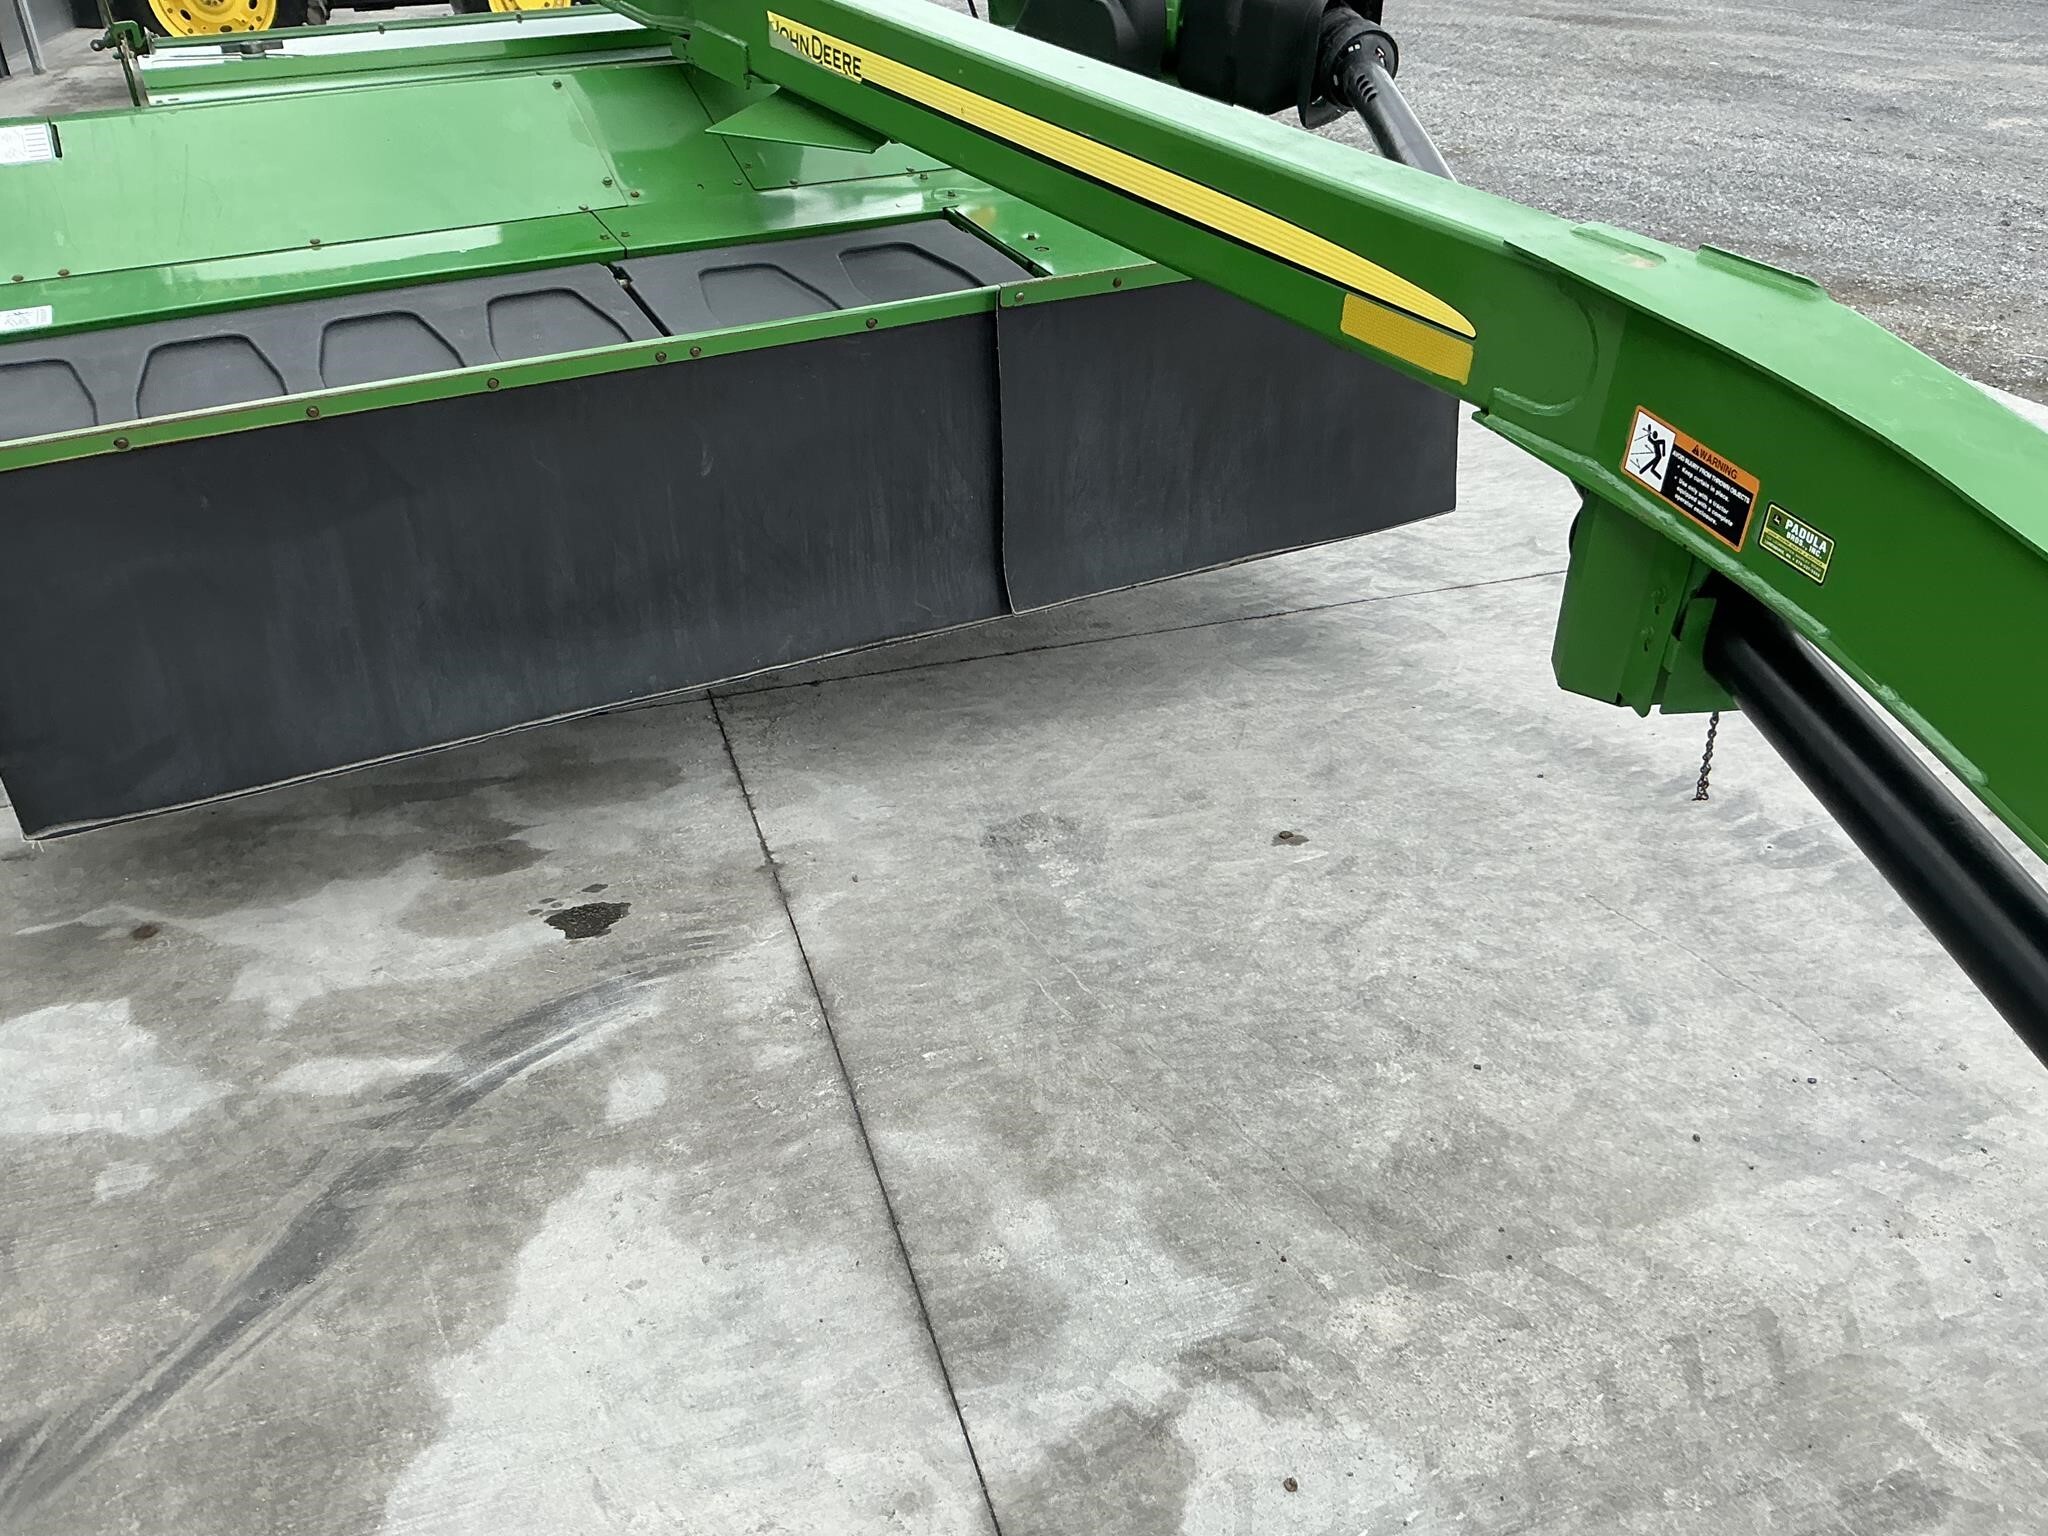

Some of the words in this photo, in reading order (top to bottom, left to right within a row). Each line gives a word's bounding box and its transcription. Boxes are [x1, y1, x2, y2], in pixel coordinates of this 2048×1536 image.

[812, 34, 861, 78] DEERE
[1681, 467, 1693, 478] Keep
[1699, 448, 1738, 479] WARNING
[1678, 478, 1688, 487] Use
[1699, 467, 1712, 479] FROM
[1711, 474, 1730, 491] THROWN
[1729, 486, 1751, 504] OBJECTS
[1785, 519, 1827, 553] PADULA
[1808, 545, 1822, 559] INC.
